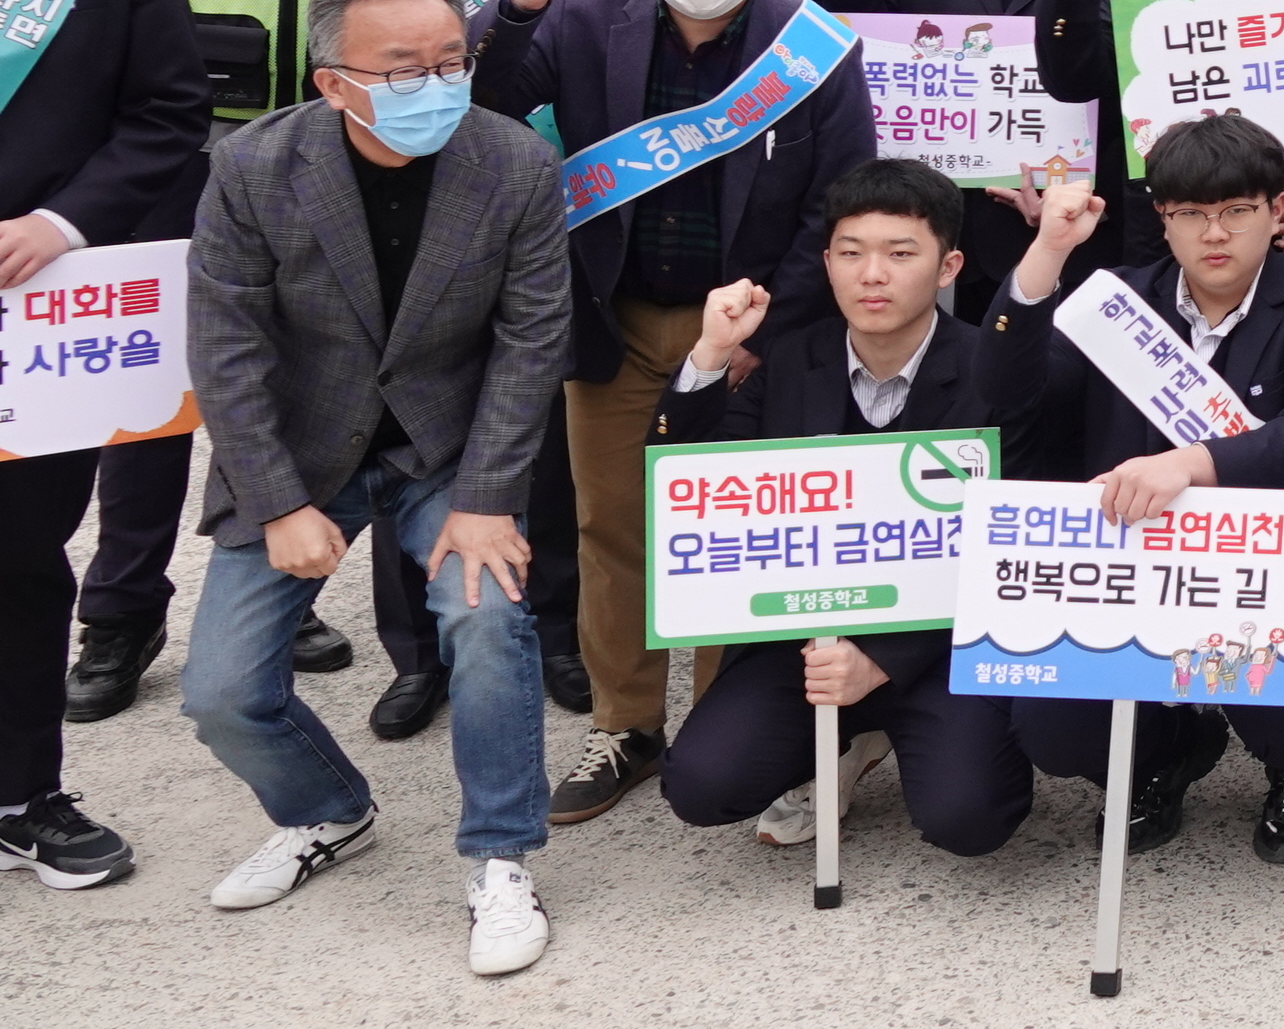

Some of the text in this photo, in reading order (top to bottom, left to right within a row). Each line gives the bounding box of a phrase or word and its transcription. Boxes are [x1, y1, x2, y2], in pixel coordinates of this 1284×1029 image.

[1164, 20, 1228, 54] 나만
[1169, 66, 1230, 104] 남은
[988, 109, 1045, 144] 가득
[24, 278, 161, 326] 대화를
[23, 329, 161, 378] 사랑을
[668, 469, 853, 520] 약속해요!
[668, 525, 819, 576] 오늘부터
[1142, 511, 1284, 555] 금연실천
[783, 589, 869, 613] 철성중학교
[995, 559, 1269, 610] 행복으로 가는 길
[974, 662, 1058, 685] 철성중학교
